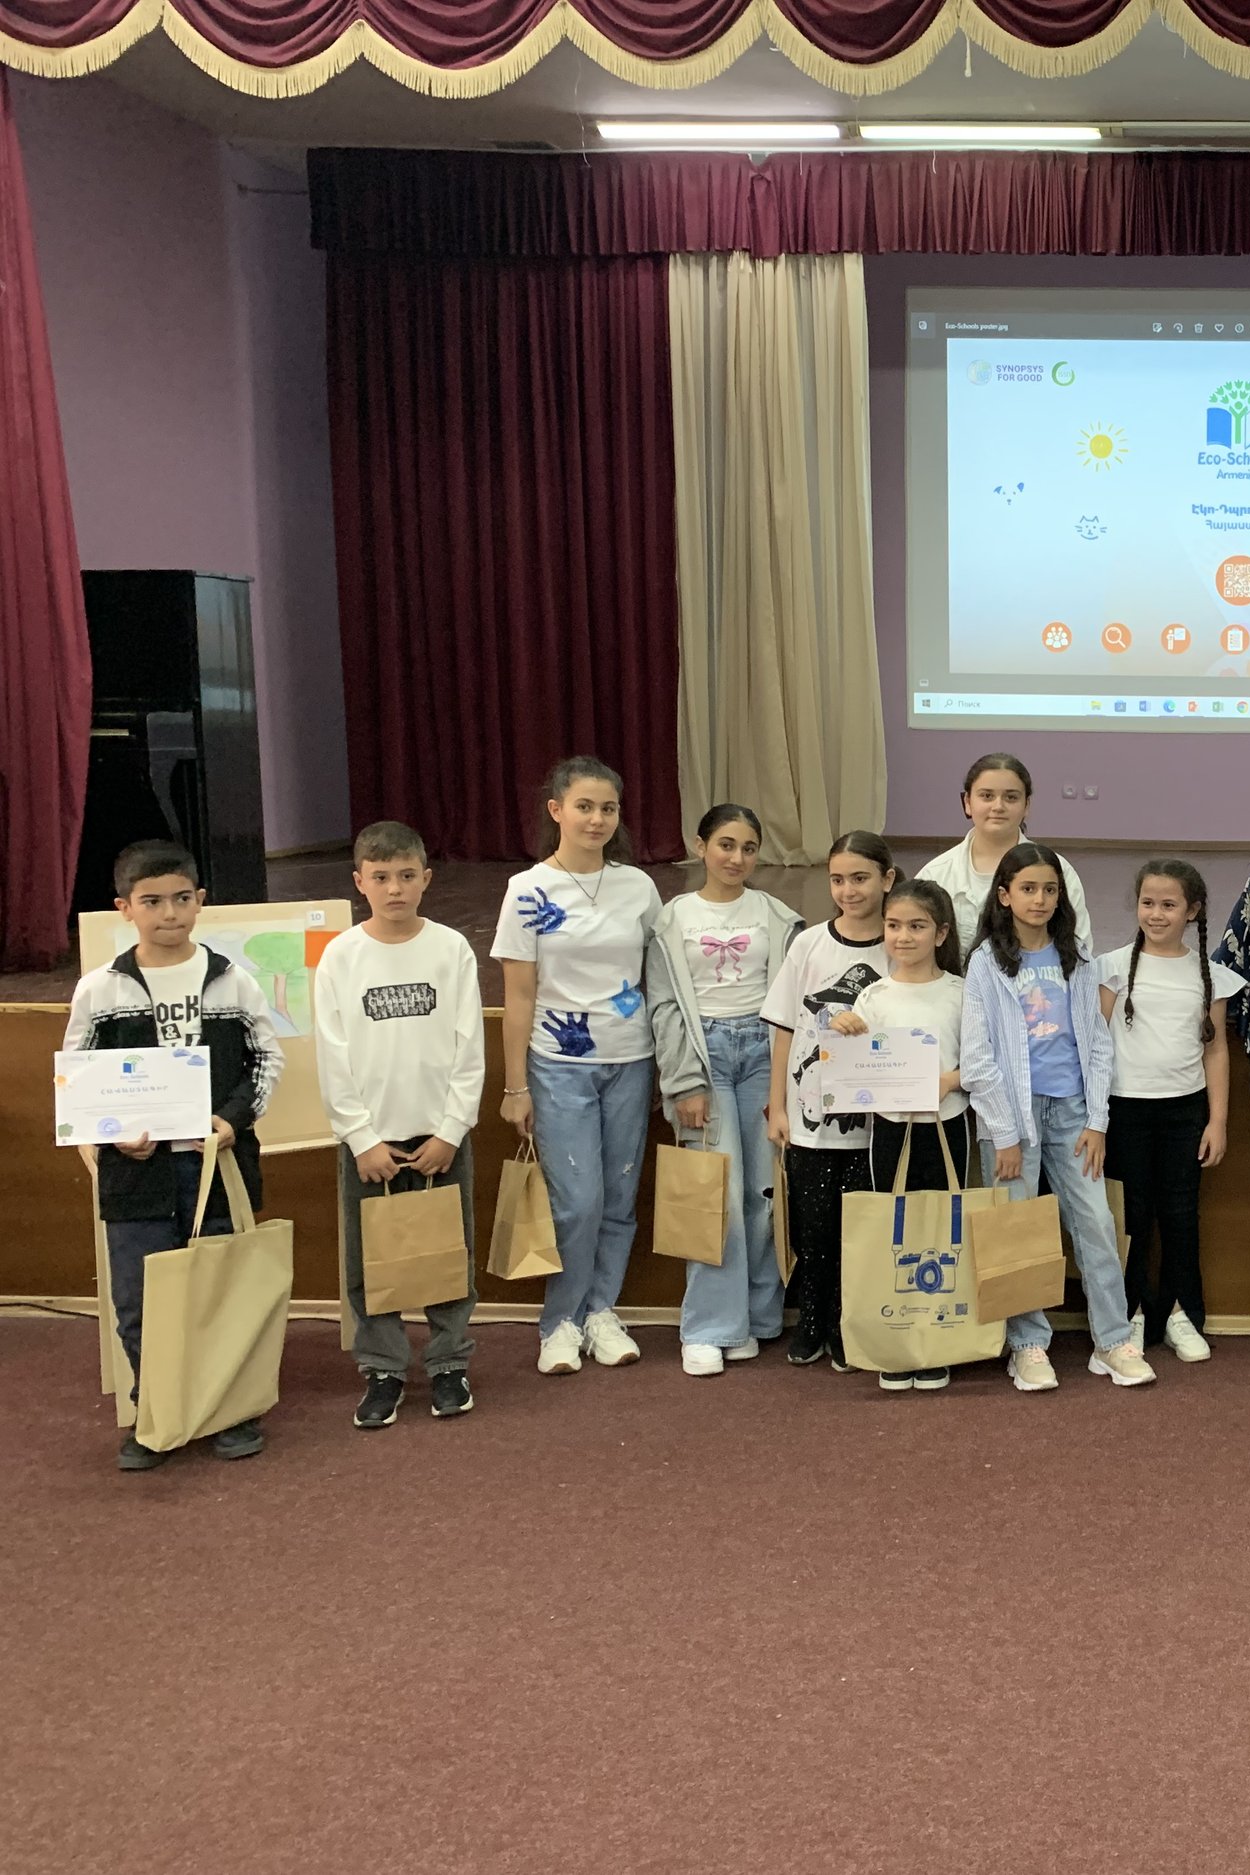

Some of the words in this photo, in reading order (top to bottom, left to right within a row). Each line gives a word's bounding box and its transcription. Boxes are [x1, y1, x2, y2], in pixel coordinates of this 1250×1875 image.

[996, 364, 1044, 373] SYNOPSYS
[1017, 374, 1042, 382] GOOD
[310, 912, 322, 921] 10
[155, 994, 200, 1025] OCK
